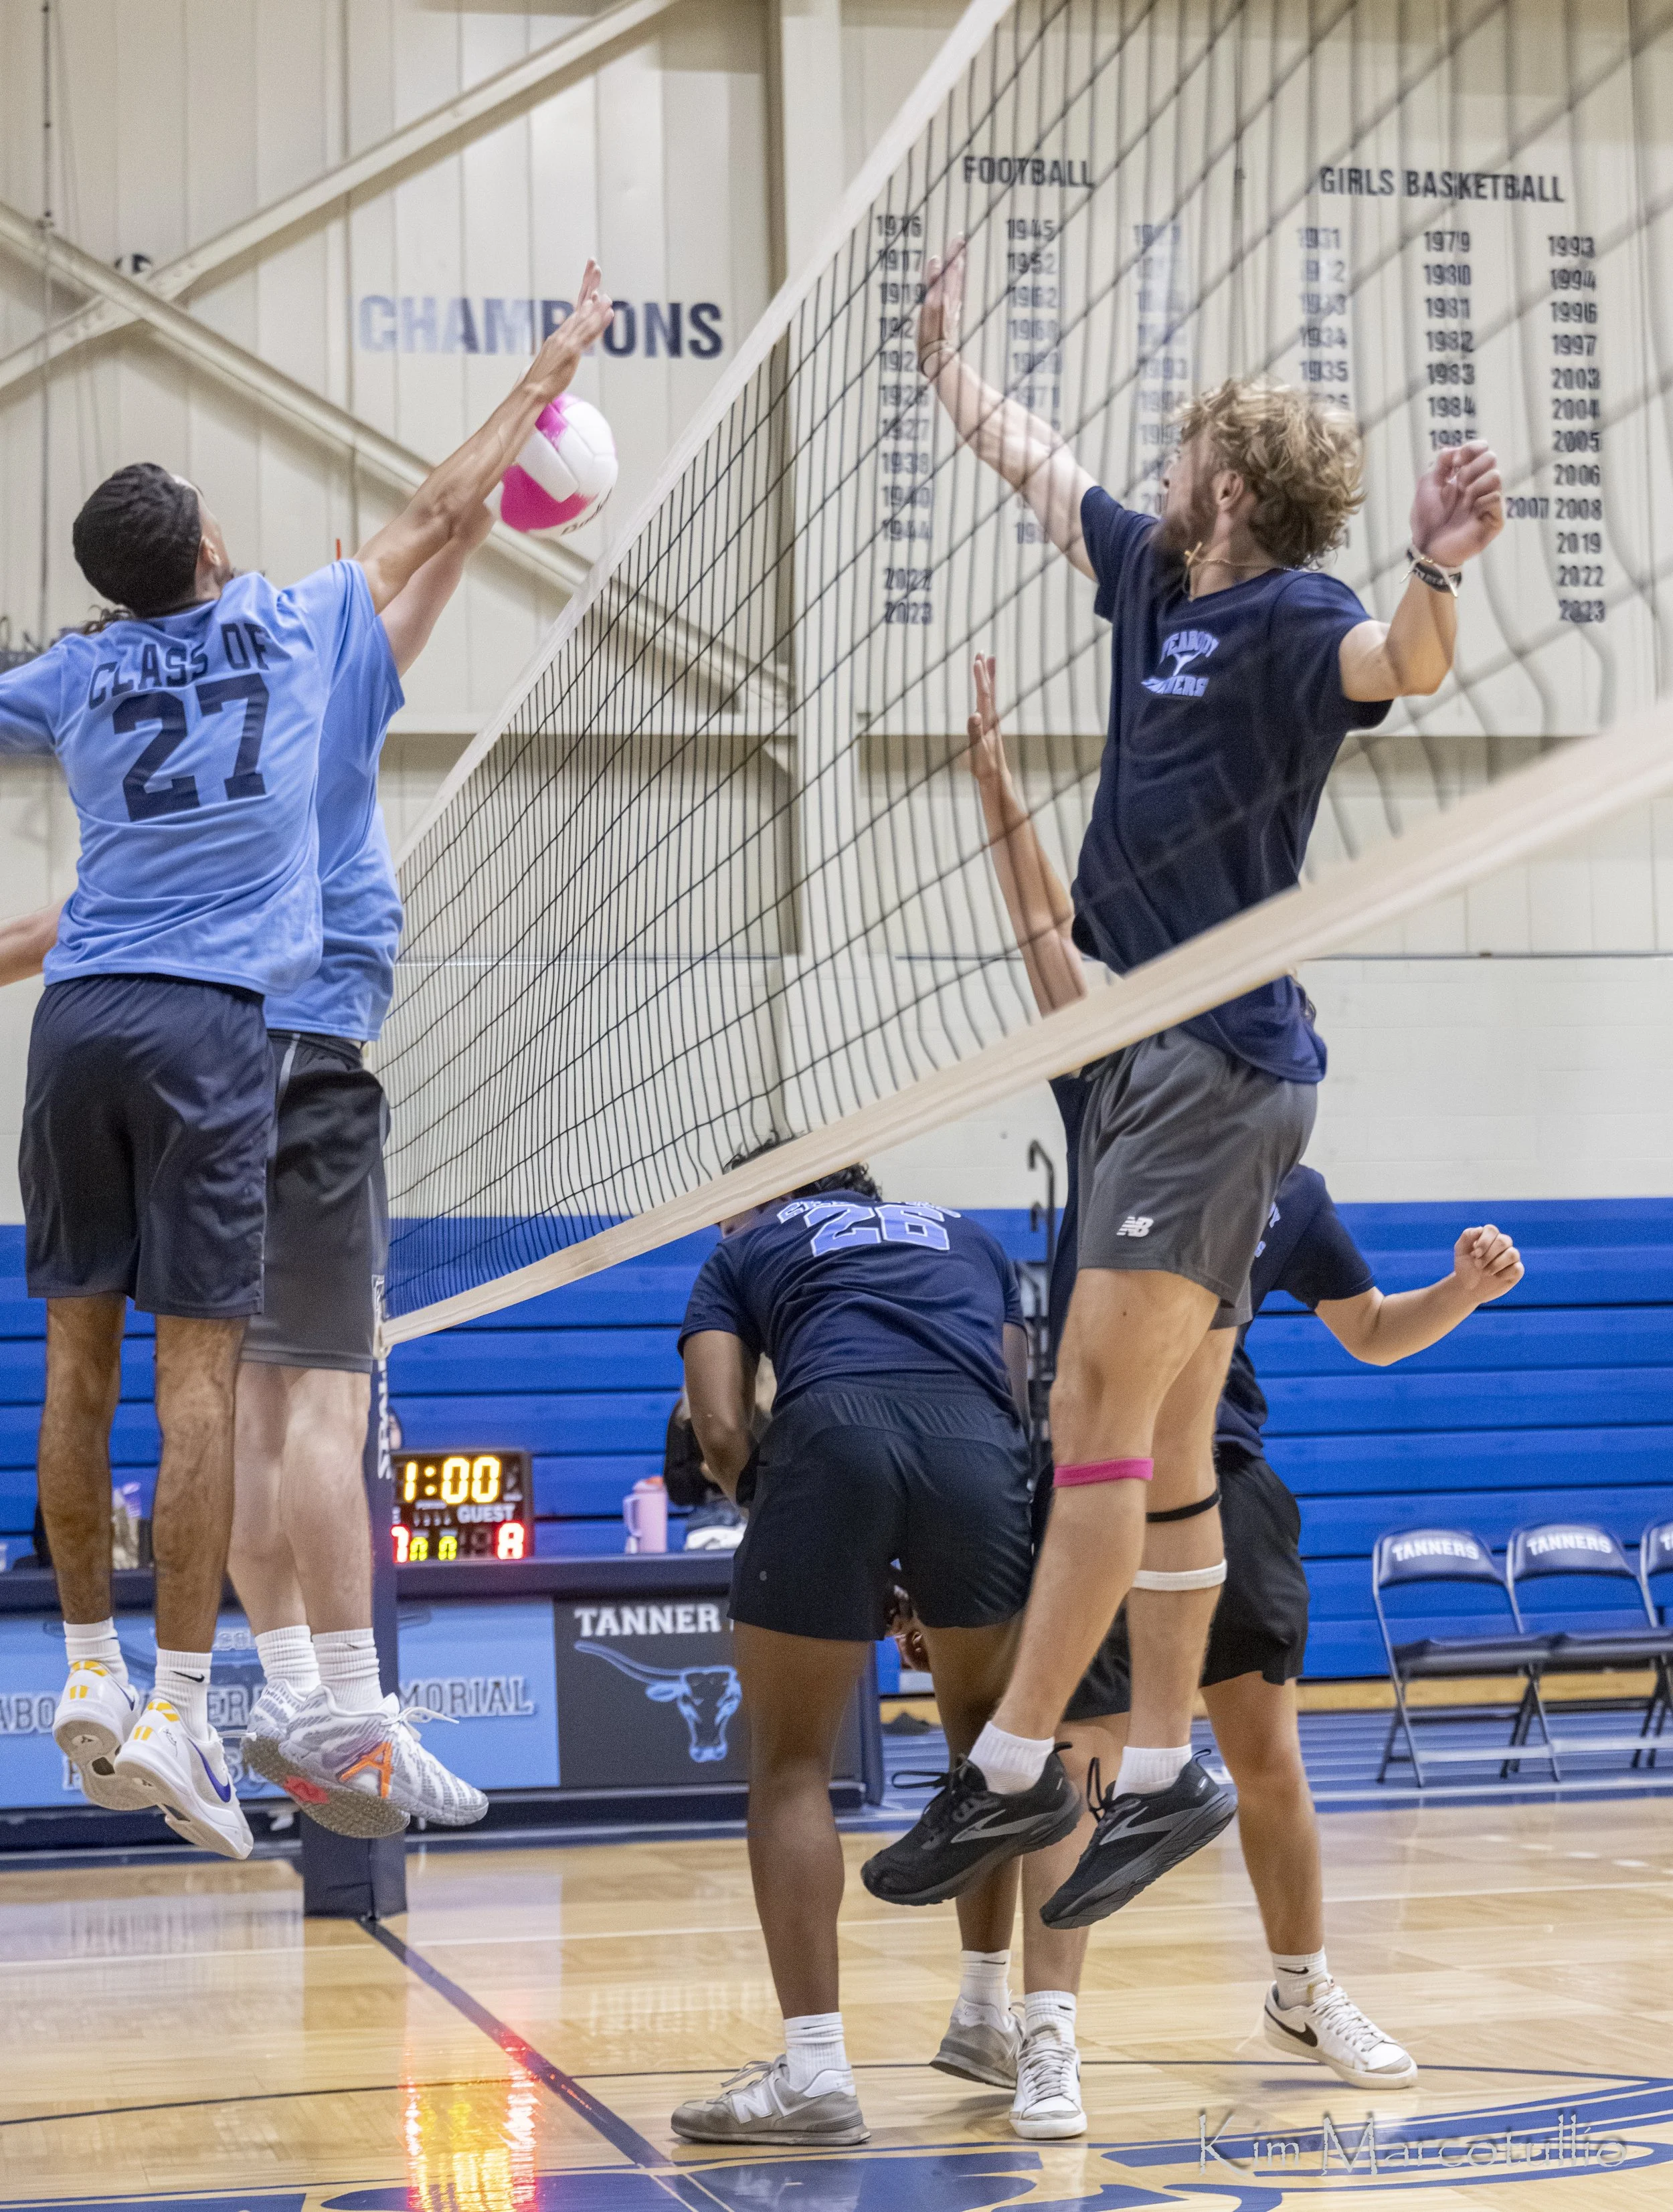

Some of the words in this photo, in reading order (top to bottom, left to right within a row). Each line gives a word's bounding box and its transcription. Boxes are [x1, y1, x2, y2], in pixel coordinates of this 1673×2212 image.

[964, 156, 1095, 188] FOOTBALL
[1320, 167, 1394, 196] GIRLS
[1406, 170, 1565, 203] BASKETBALL
[1006, 219, 1056, 241] 1945
[1423, 231, 1470, 252] 1979
[1548, 236, 1595, 258] 1993
[877, 249, 922, 271] 1917
[1551, 268, 1596, 291] 1994
[1551, 301, 1597, 323] 1996
[358, 294, 723, 360] CHAMPONS
[880, 316, 914, 339] 192
[1551, 335, 1597, 356] 1997
[879, 351, 916, 372] 192
[1300, 360, 1348, 382] 1935
[1426, 363, 1475, 385] 1983
[1551, 367, 1600, 390] 2003
[1427, 396, 1476, 418] 1984
[1552, 398, 1600, 420] 2004
[1553, 430, 1600, 452] 2005
[1554, 464, 1600, 486] 2006
[1506, 496, 1549, 520] 2007
[1555, 498, 1603, 521] 2008
[1557, 532, 1602, 554] 2019
[1558, 565, 1605, 587] 2022
[89, 642, 208, 710] CLASS
[220, 623, 270, 670] OF
[112, 672, 270, 822] 27
[804, 1204, 950, 1257] 26
[404, 1455, 501, 1504] 1:00
[457, 1503, 516, 1524] GUEST
[1392, 1538, 1480, 1562] TANNERS
[1526, 1532, 1612, 1556] TANNERS
[574, 1603, 726, 1637] TANNER
